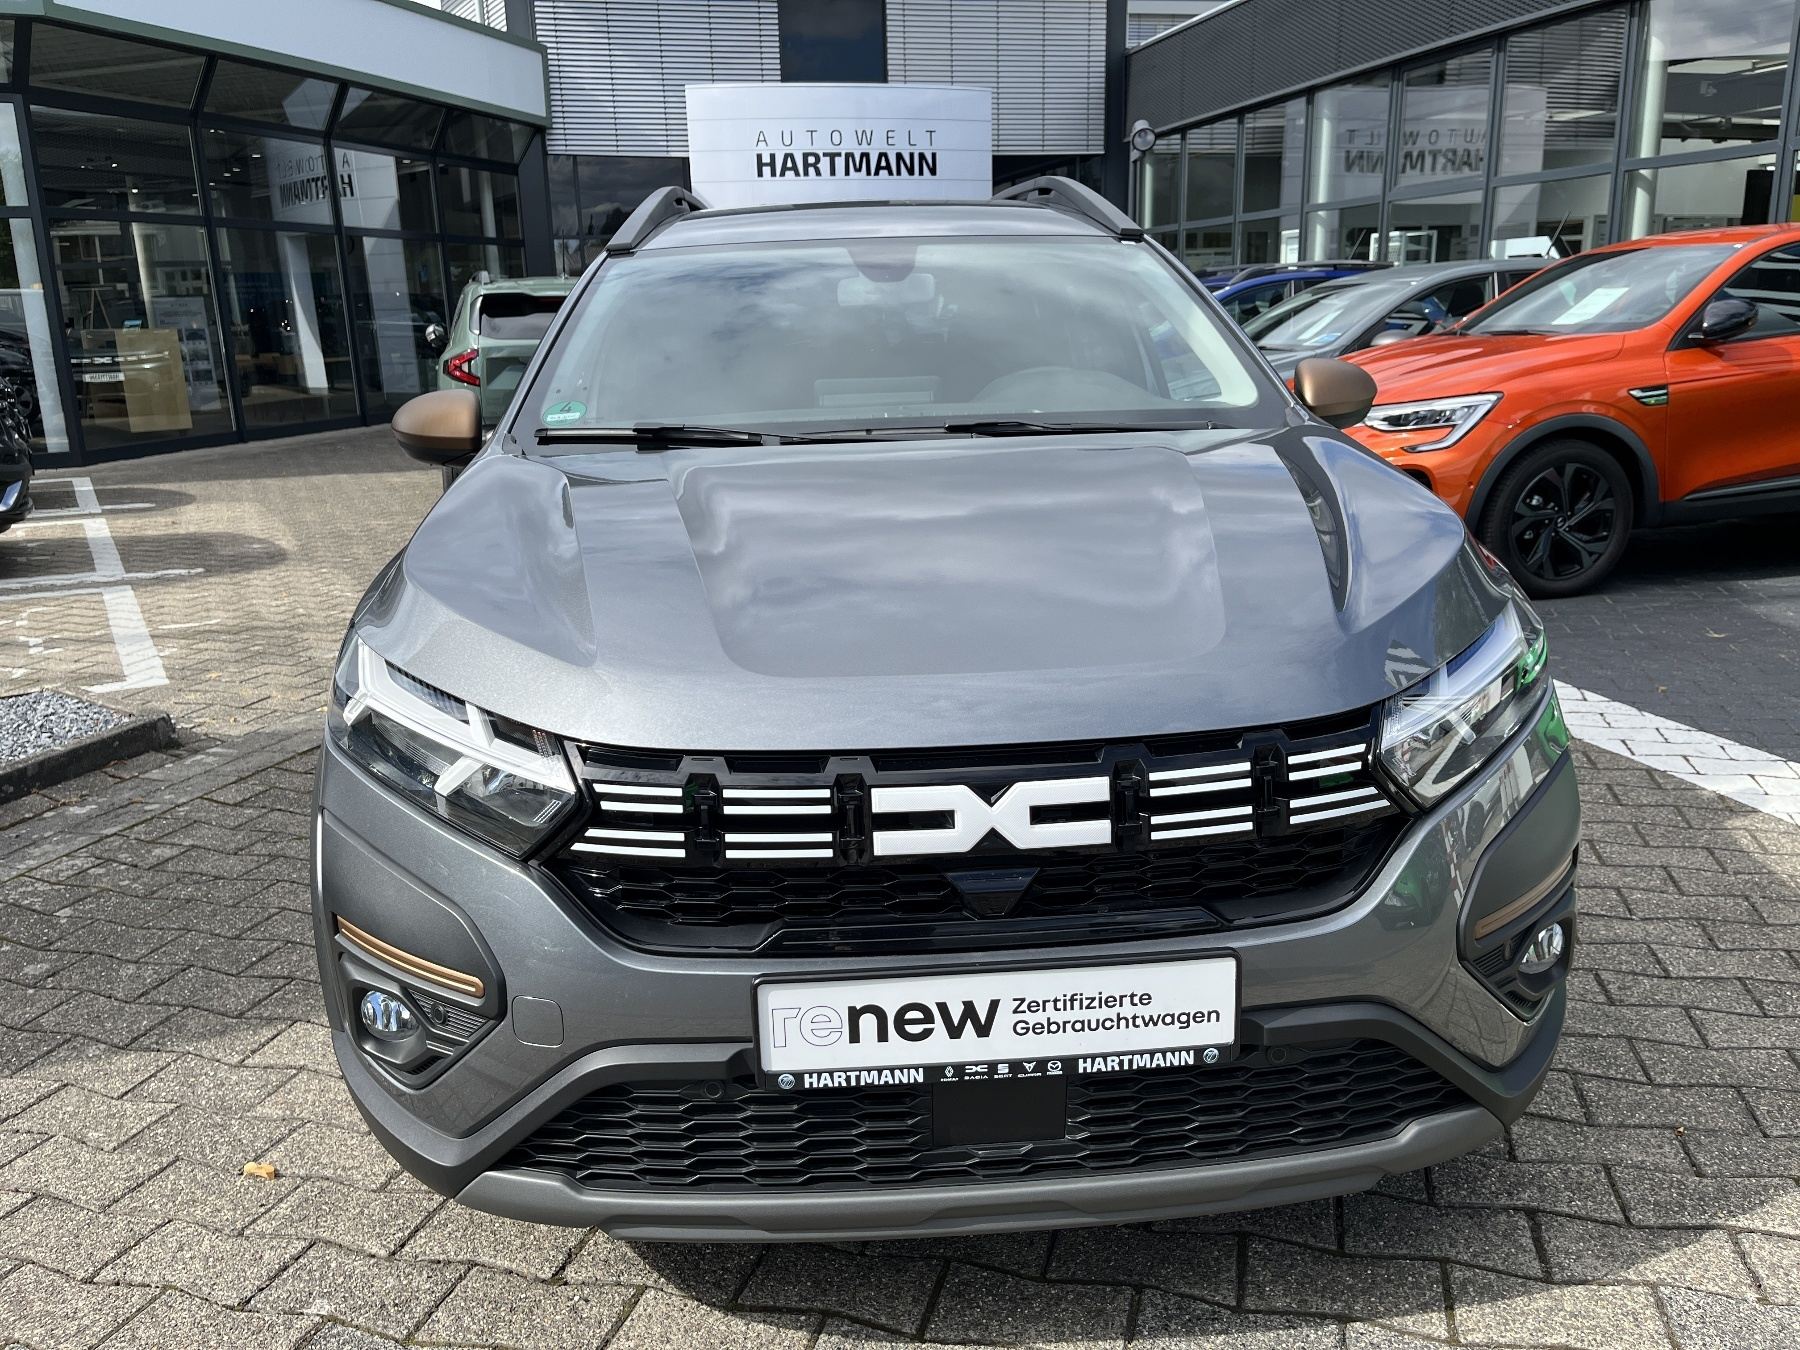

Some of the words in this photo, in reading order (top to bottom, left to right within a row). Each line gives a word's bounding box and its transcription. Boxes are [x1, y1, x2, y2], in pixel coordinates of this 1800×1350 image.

[756, 130, 937, 147] AUTOWELT
[756, 151, 937, 178] HARTMANN
[1012, 991, 1153, 1015] Zertifizierte
[771, 998, 1001, 1048] renew
[1012, 1009, 1221, 1037] Gebrauchtwagen
[1078, 1049, 1195, 1074] HARTMANN
[804, 1067, 924, 1089] HARTMANN
